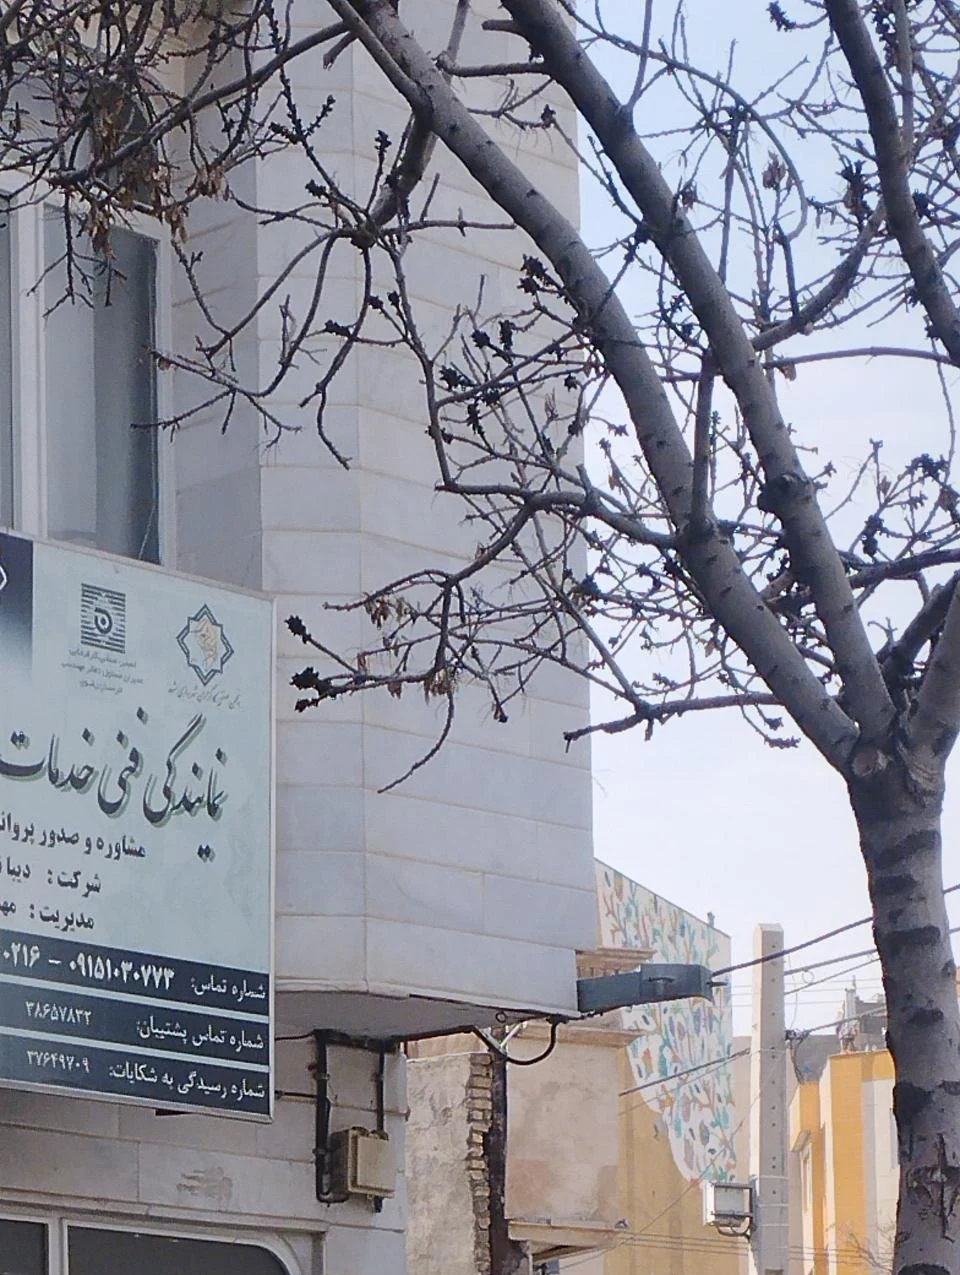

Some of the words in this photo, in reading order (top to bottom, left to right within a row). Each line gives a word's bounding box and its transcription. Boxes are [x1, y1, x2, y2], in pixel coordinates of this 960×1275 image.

[40, 828, 80, 848] صدور
[84, 837, 92, 855] و
[96, 833, 146, 860] مشاوره
[232, 979, 266, 1001] شماره
[192, 1024, 227, 1047] تماس
[230, 1031, 264, 1052] شماره
[162, 1073, 174, 1090] به
[178, 1072, 227, 1098] رسیدگی
[231, 1080, 266, 1101] شماره
